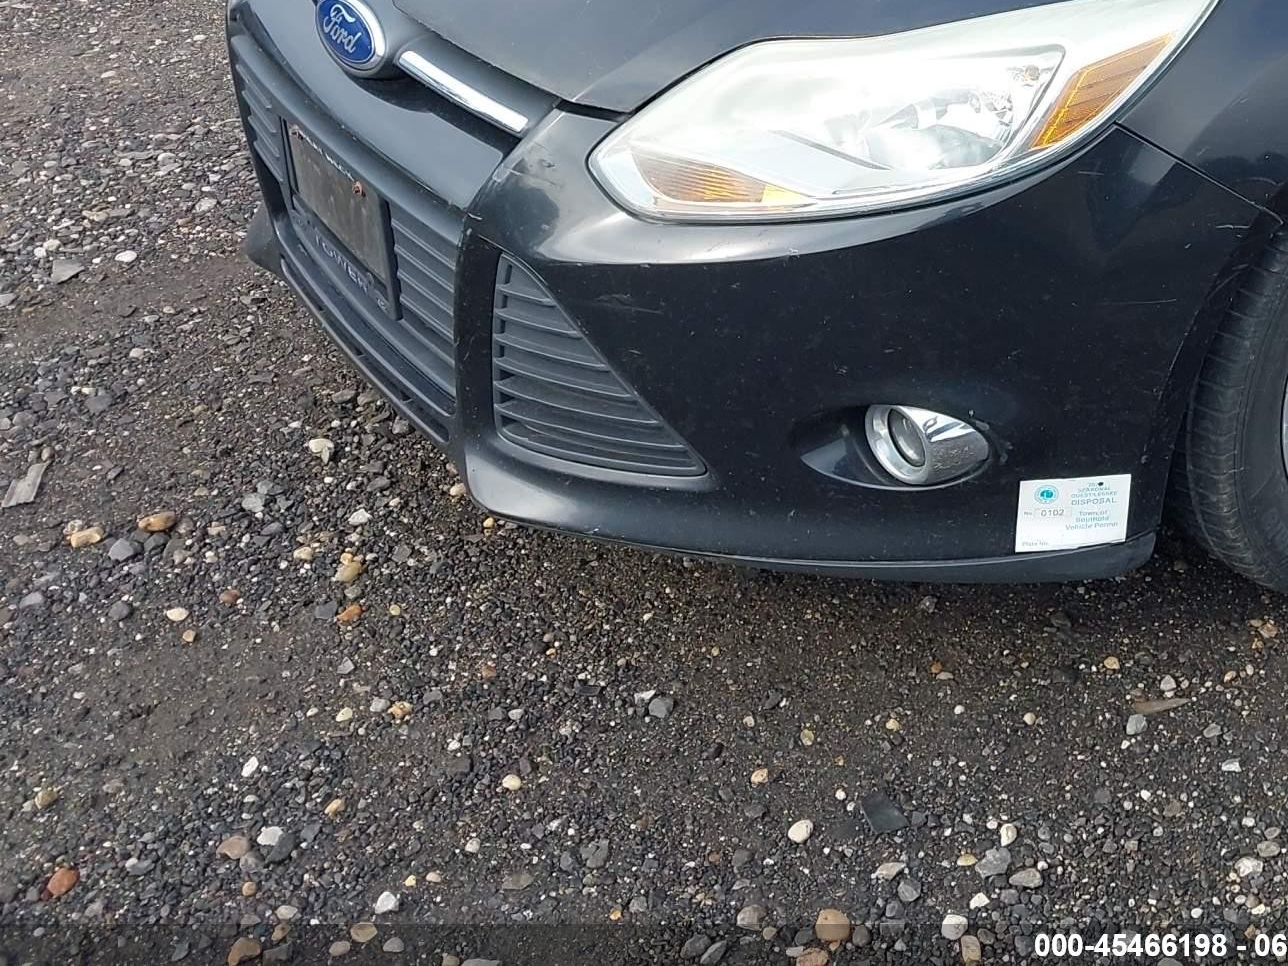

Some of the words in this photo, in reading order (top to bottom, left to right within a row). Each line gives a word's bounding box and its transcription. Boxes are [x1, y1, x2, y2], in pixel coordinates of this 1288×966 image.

[323, 4, 362, 53] Ford
[1071, 498, 1117, 506] DISPOSAL
[1040, 509, 1065, 517] 0102
